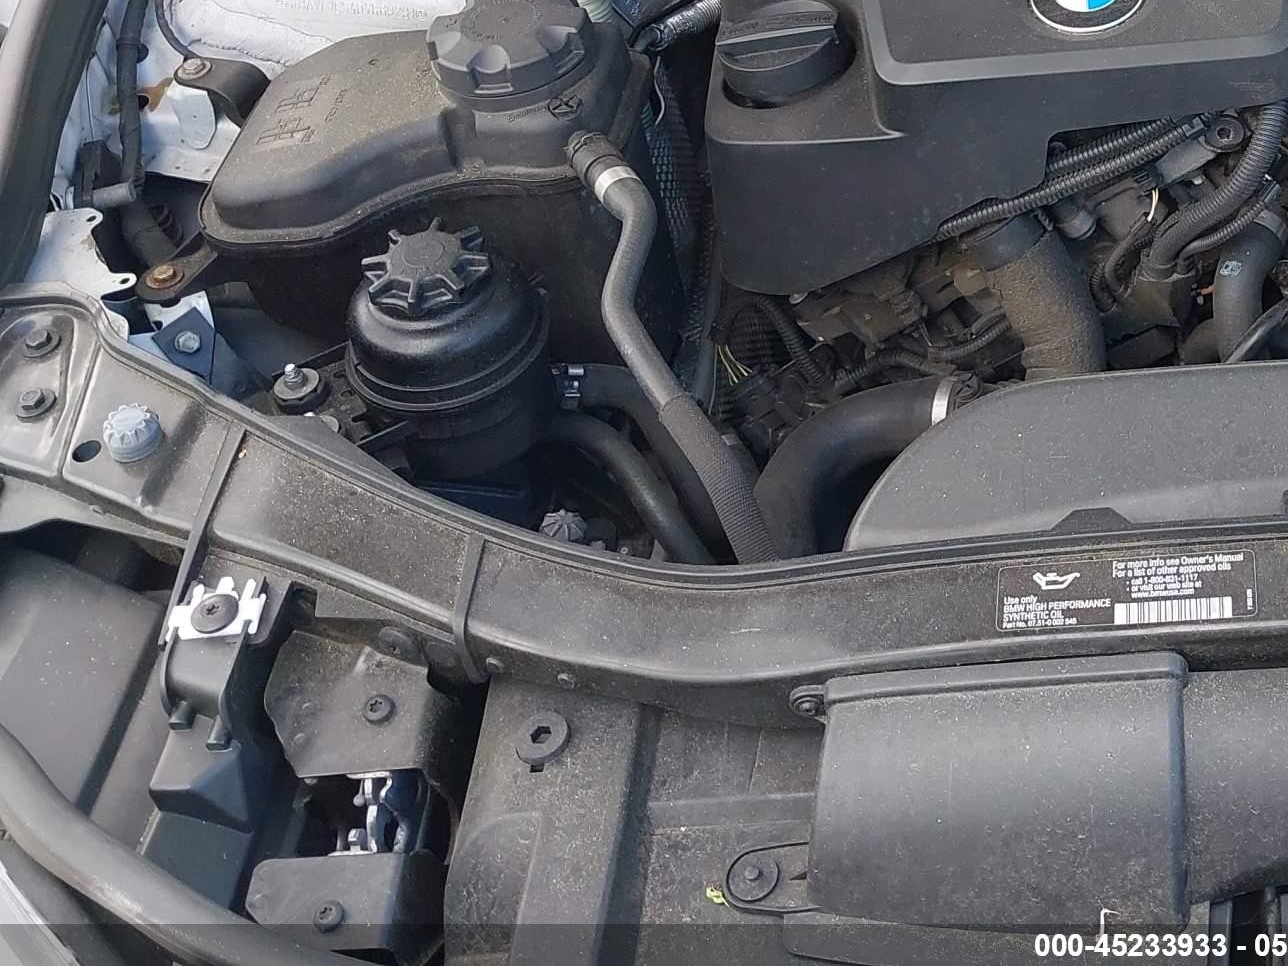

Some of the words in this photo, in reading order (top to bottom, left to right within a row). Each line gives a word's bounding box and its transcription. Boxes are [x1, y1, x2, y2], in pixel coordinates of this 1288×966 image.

[1112, 561, 1126, 570] For
[1127, 560, 1148, 569] more
[1166, 558, 1180, 566] see
[1181, 554, 1213, 565] Owner's
[1214, 553, 1243, 563] Manual
[1112, 569, 1126, 578] For
[1133, 567, 1145, 577] list
[1146, 567, 1155, 575] of
[1156, 565, 1178, 574] other
[1179, 562, 1216, 574] approved
[1218, 561, 1231, 571] oils
[1131, 577, 1143, 585] call
[1139, 583, 1153, 591] visit
[1154, 582, 1165, 590] our
[1166, 581, 1181, 589] web
[1182, 579, 1196, 588] site
[1004, 596, 1019, 605] Use
[1020, 594, 1038, 605] only
[1003, 604, 1025, 614] BMW
[1026, 602, 1047, 612] HIGH
[1048, 598, 1111, 610] PERFORMANCE
[1003, 611, 1049, 622] SYNTHETIC
[1050, 609, 1064, 619] OIL
[1002, 621, 1015, 629] Part
